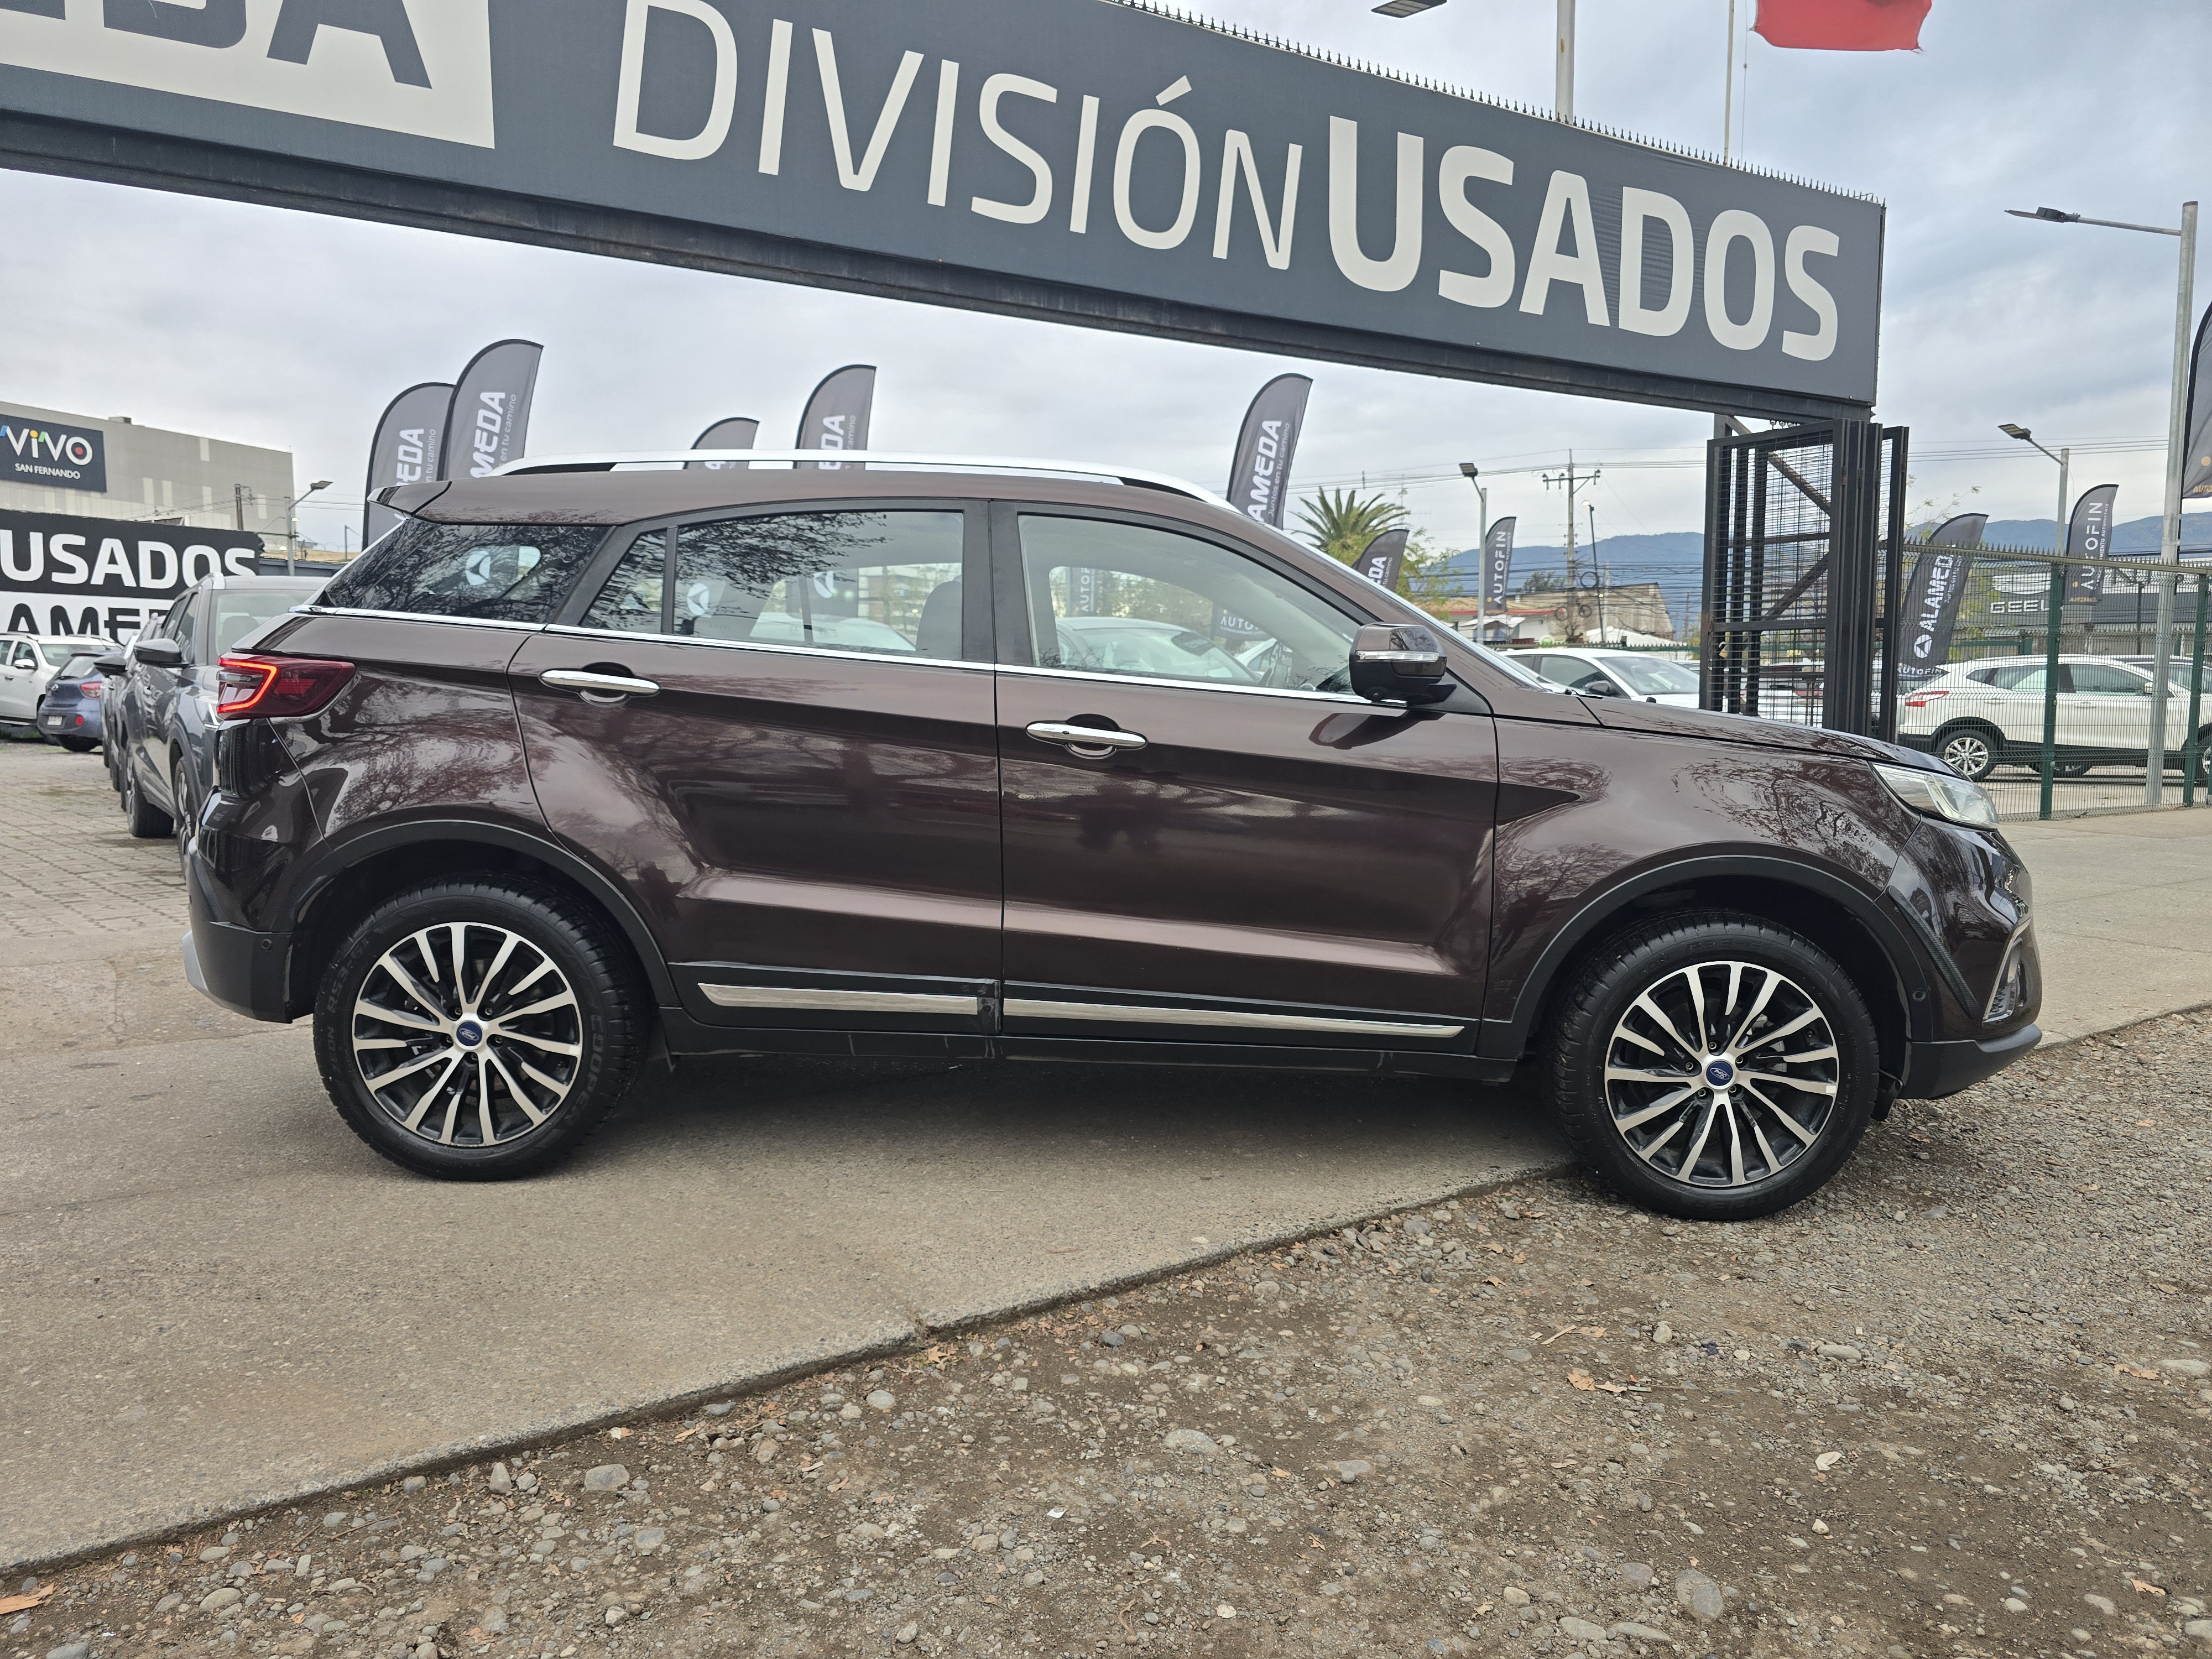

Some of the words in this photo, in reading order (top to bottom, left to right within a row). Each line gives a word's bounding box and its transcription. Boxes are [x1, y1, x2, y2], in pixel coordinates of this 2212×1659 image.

[613, 0, 1302, 270] DIVISIÓN
[1329, 115, 1840, 361] USADOS
[504, 393, 517, 433] camino
[396, 428, 424, 486] EDA
[1279, 422, 1290, 458] camino
[15, 463, 33, 473] SAN
[34, 466, 81, 479] FERNANDO
[0, 529, 257, 589] USADOS
[1493, 531, 1506, 604] AUTOFIN
[1919, 544, 1957, 632] ALAMED
[1991, 599, 2050, 613] GEEL
[7, 603, 169, 646] AME
[1220, 615, 1259, 630] AUTO
